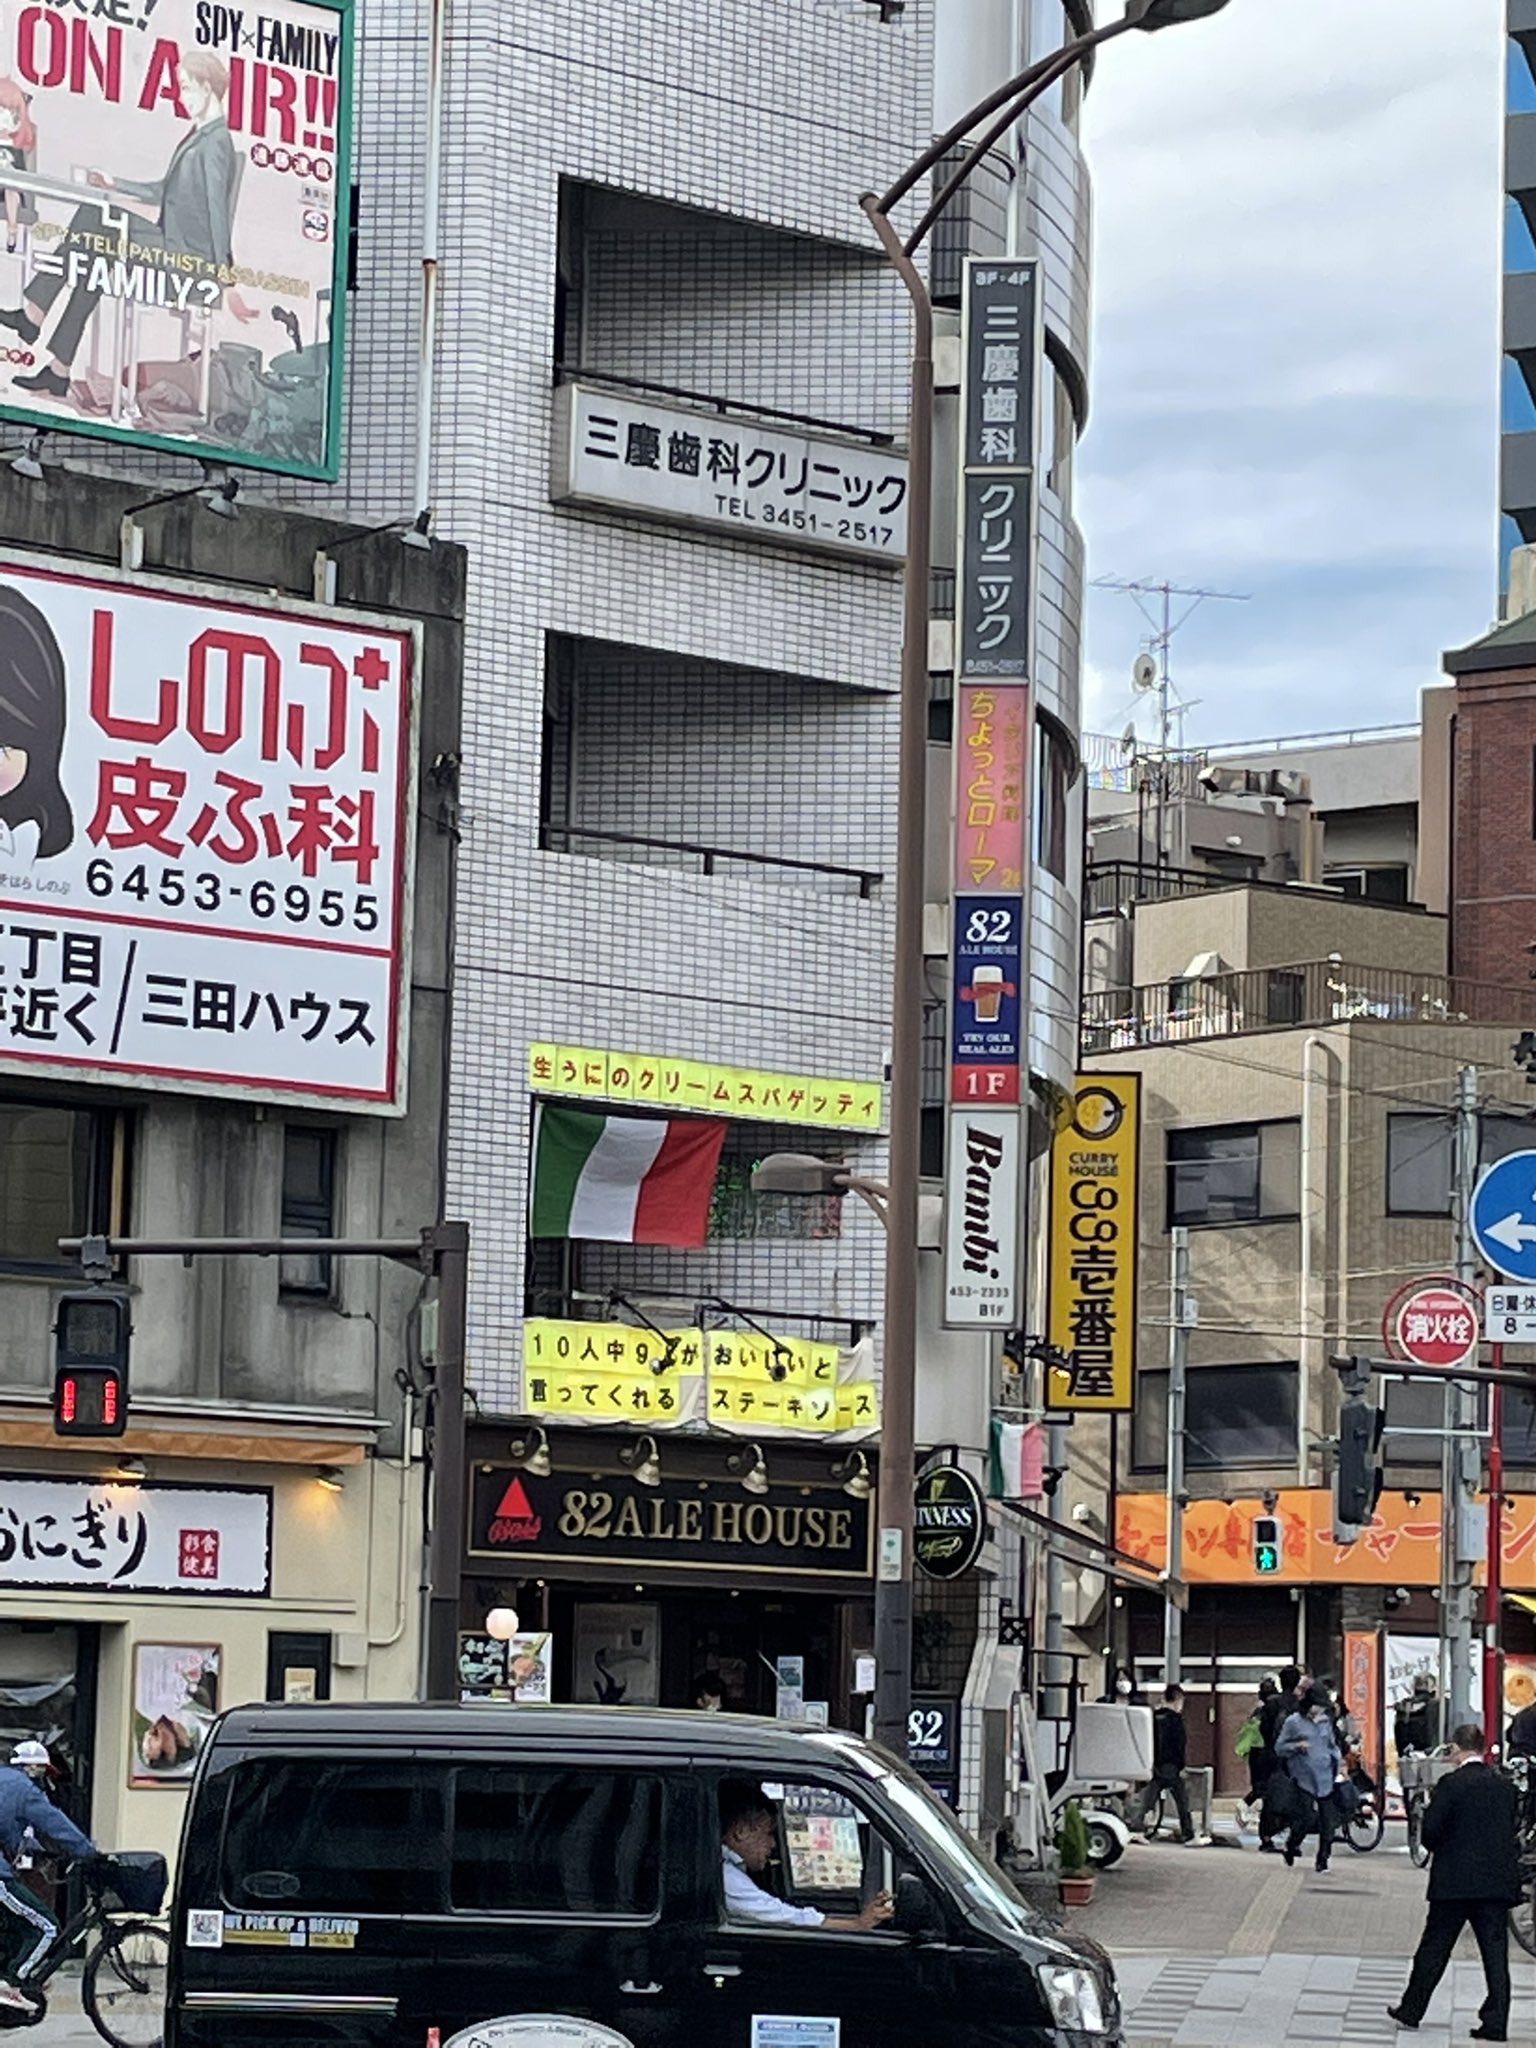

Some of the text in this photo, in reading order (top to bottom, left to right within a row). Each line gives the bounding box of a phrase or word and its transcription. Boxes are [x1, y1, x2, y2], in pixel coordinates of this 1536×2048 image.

[17, 6, 122, 103] ON
[585, 414, 906, 514] 三慶歯科クリニック
[714, 494, 893, 546] TEL 3451-2517
[976, 485, 1015, 650] クリニック
[89, 609, 390, 773] しのぶ
[85, 758, 379, 885] 皮ふ科
[966, 691, 997, 884] ちょっとローマ
[86, 858, 379, 931] 6453-6955
[966, 910, 1011, 943] 82
[0, 923, 102, 988] 丁目
[0, 984, 97, 1046] 近く
[142, 973, 376, 1046] 三田ハウス
[533, 1335, 699, 1366] 10人中9が
[1405, 1313, 1472, 1344] 消火栓
[712, 1501, 853, 1549] HOUSE
